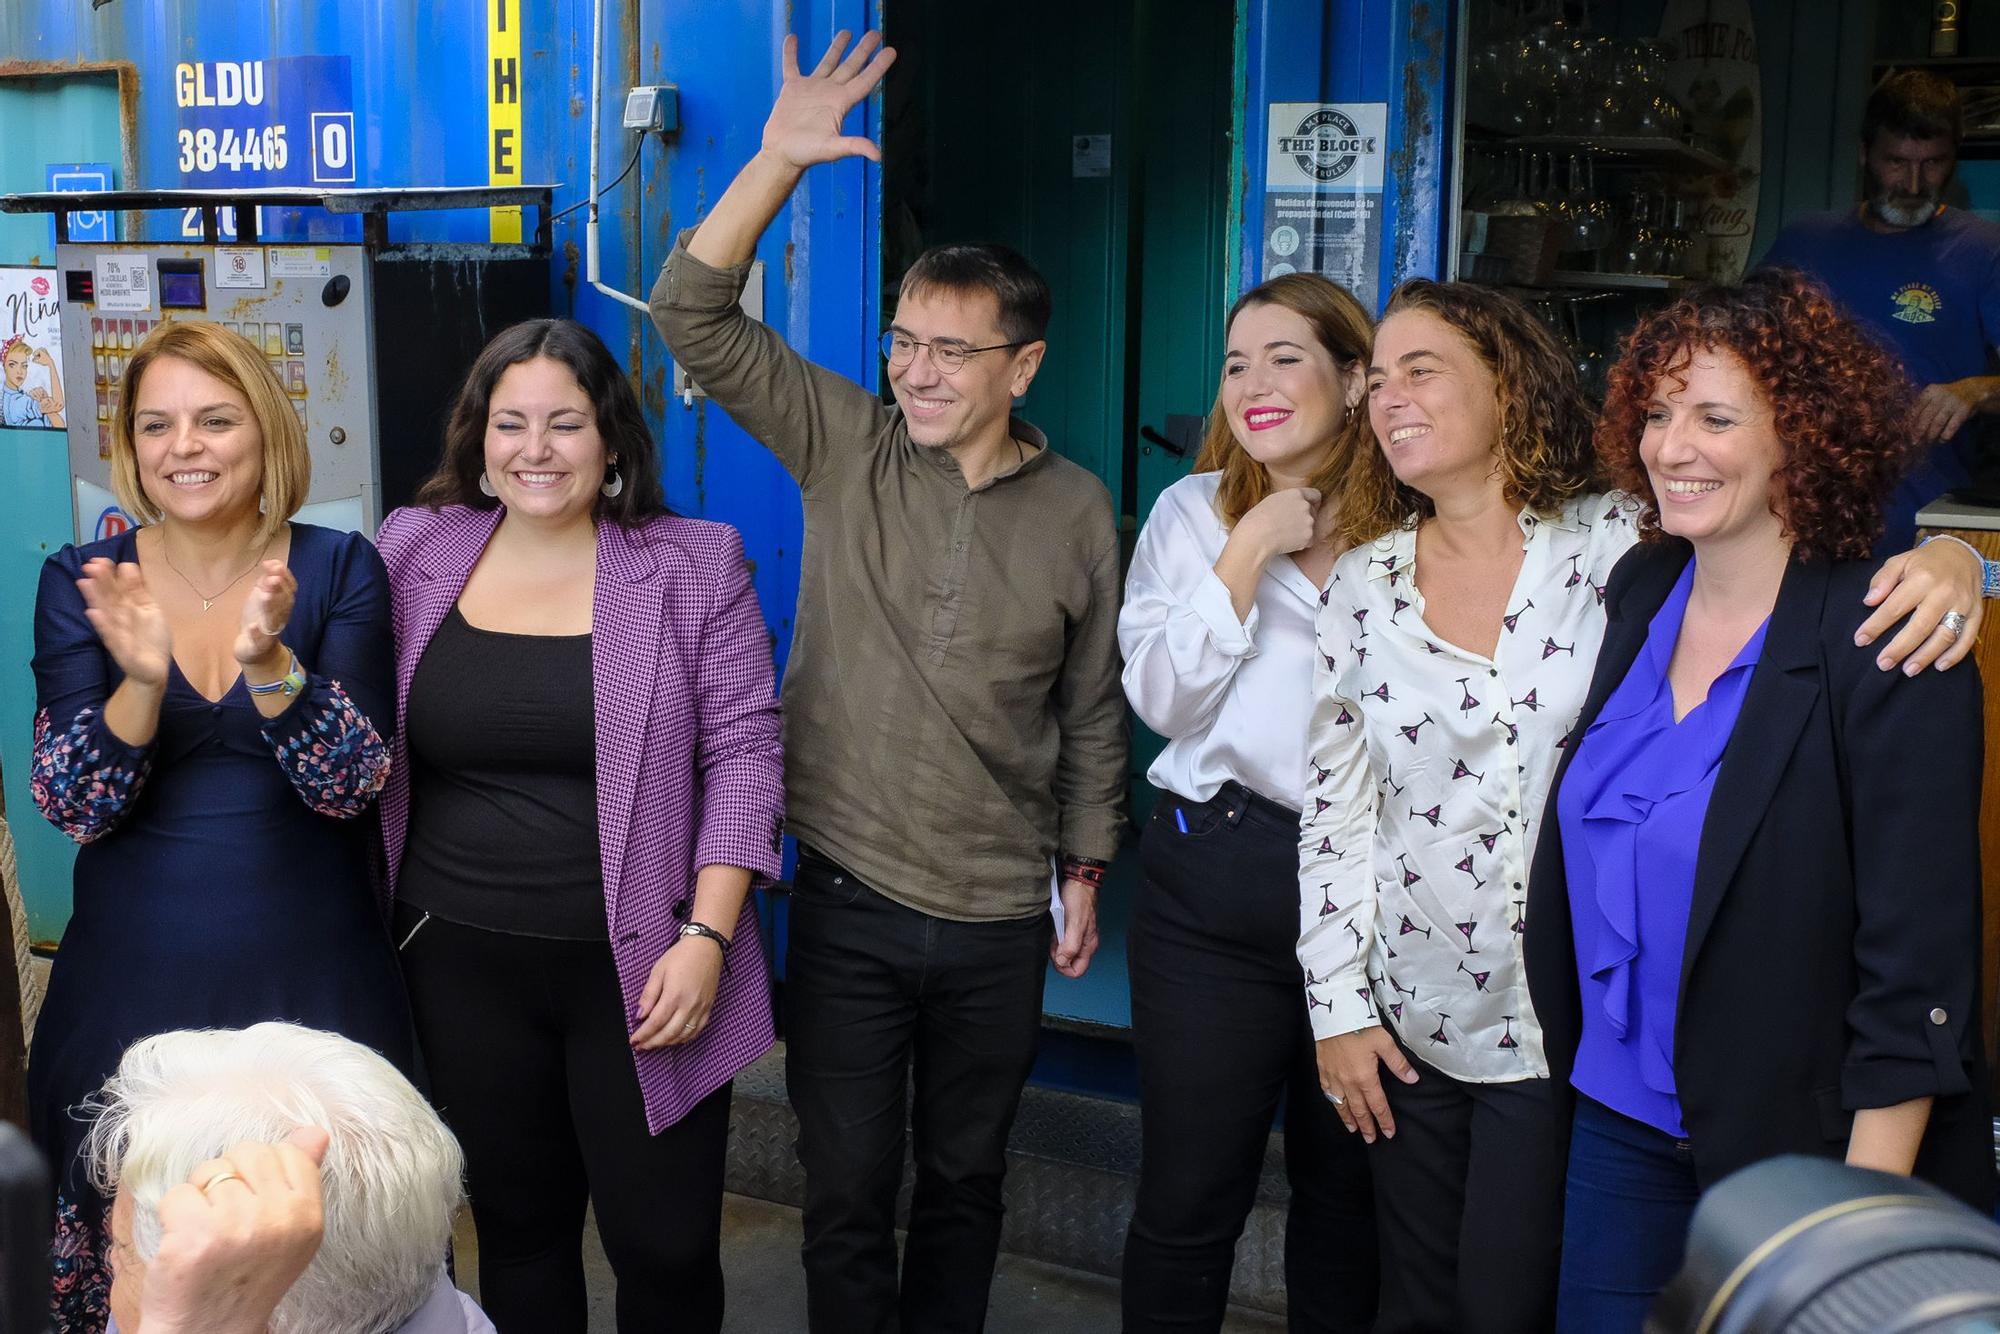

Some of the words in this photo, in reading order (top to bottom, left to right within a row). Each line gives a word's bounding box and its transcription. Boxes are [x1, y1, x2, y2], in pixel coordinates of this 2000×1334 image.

[175, 60, 264, 108] GLDU
[1304, 115, 1319, 130] MY
[1322, 114, 1351, 130] PLACE
[178, 124, 288, 173] 384465
[1278, 137, 1315, 153] THE
[1319, 137, 1376, 153] BLOCK
[1320, 161, 1349, 178] RULES
[1275, 198, 1305, 207] Medidas
[1306, 199, 1316, 207] de
[1355, 199, 1365, 208] de
[1366, 200, 1375, 208] la
[1321, 210, 1334, 219] del
[106, 262, 120, 274] 70%
